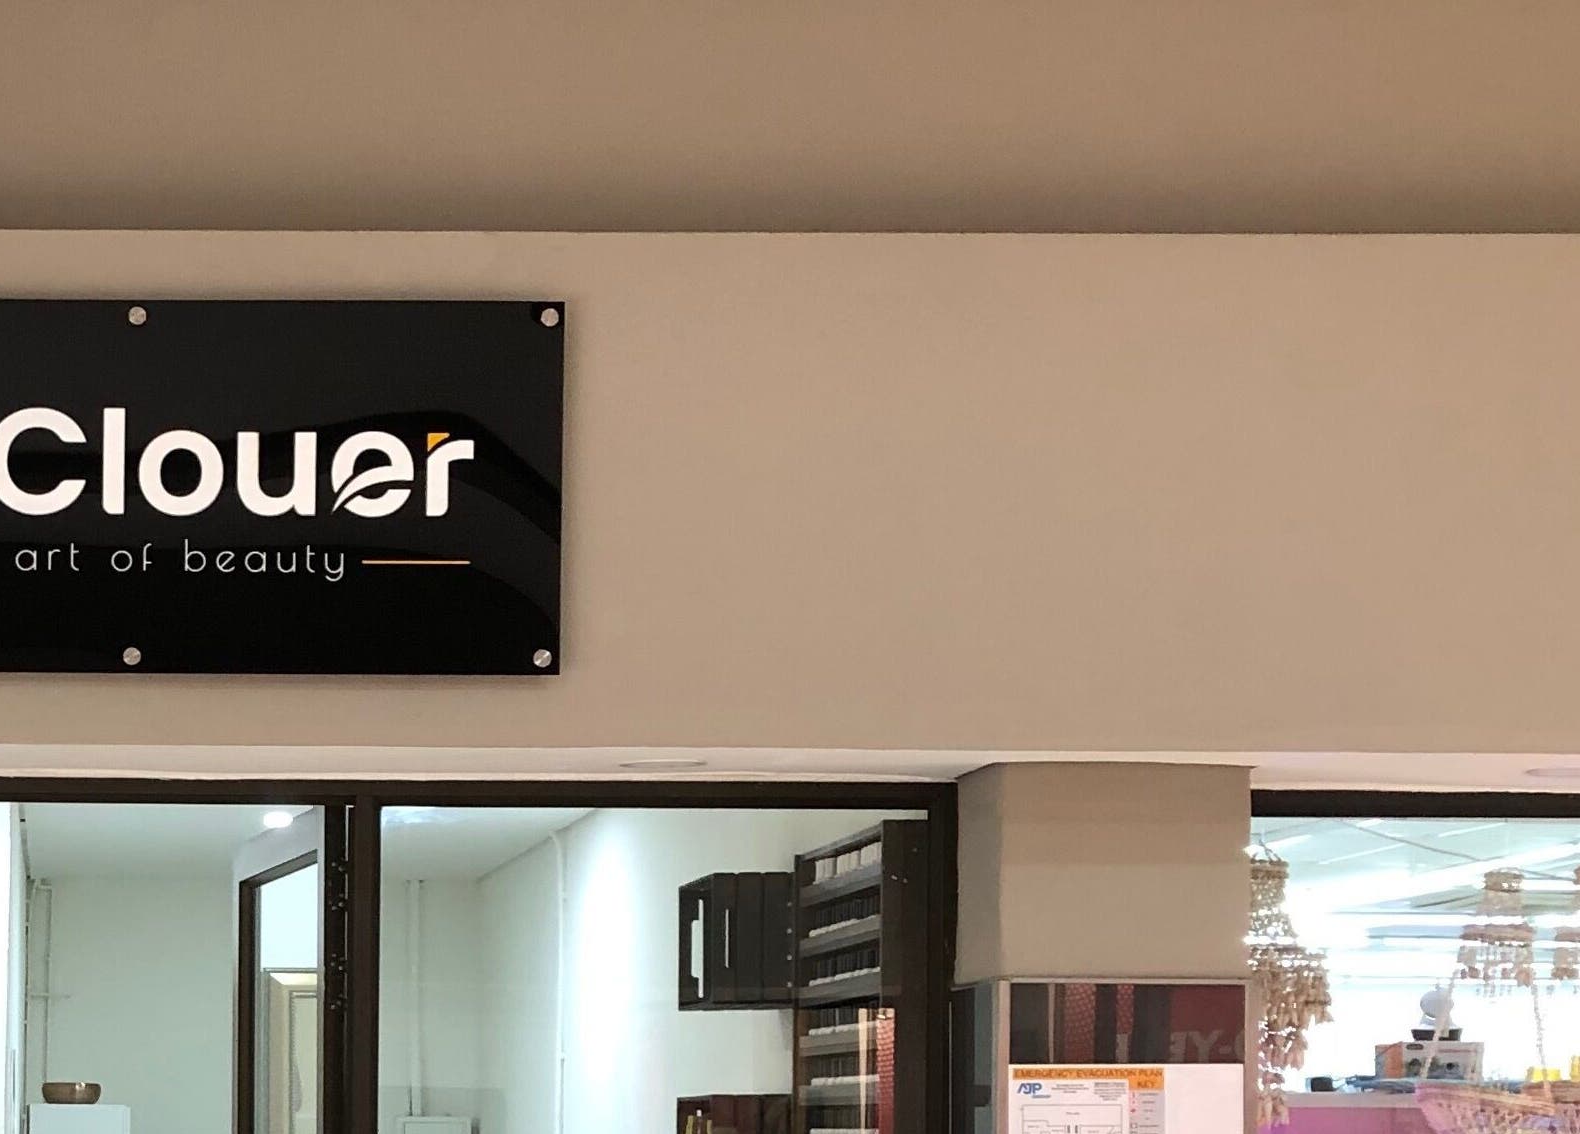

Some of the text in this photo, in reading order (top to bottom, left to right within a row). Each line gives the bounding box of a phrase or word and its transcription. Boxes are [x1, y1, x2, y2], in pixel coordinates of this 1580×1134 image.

[16, 540, 80, 572] art
[111, 542, 152, 572] of
[185, 540, 346, 581] beauty
